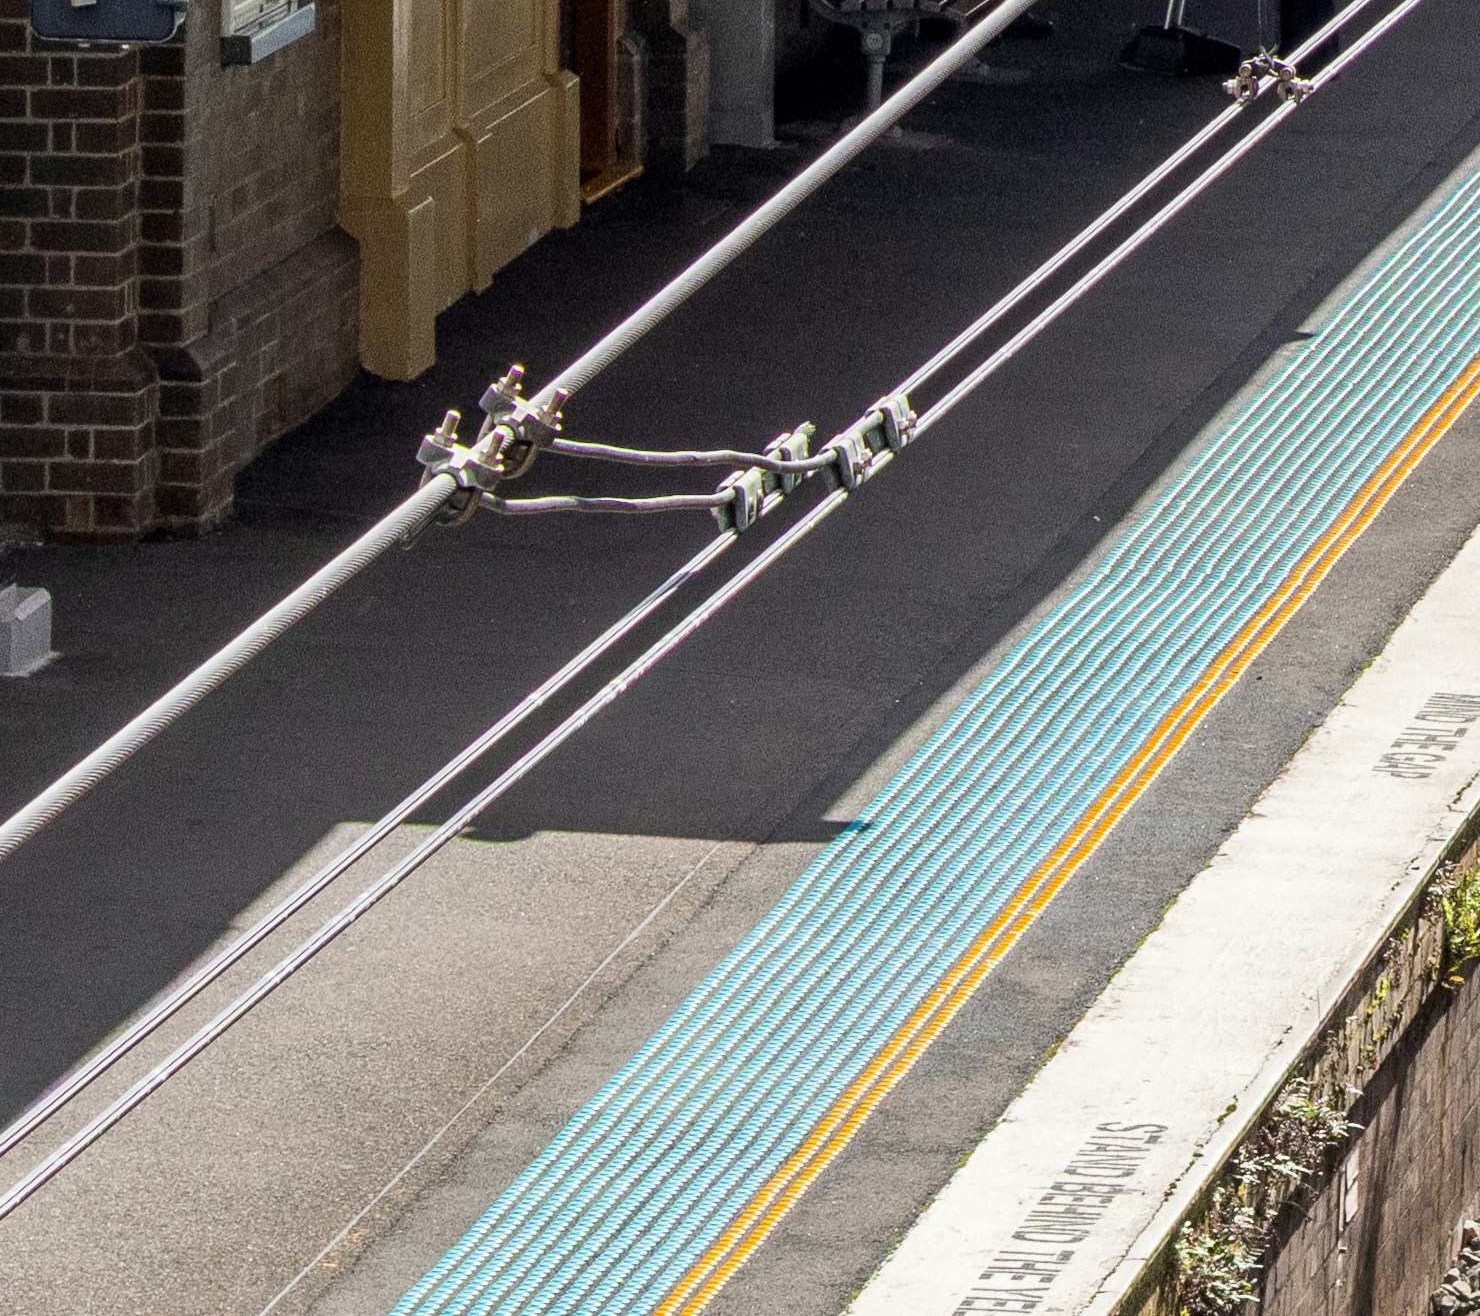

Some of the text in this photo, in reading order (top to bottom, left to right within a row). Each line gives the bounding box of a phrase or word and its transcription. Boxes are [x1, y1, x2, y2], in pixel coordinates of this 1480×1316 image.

[1390, 728, 1469, 750] THE
[1371, 752, 1447, 779] GAP
[1063, 1122, 1169, 1178] STAND
[1011, 1181, 1125, 1244] BEHIND
[978, 1250, 1076, 1283] THE
